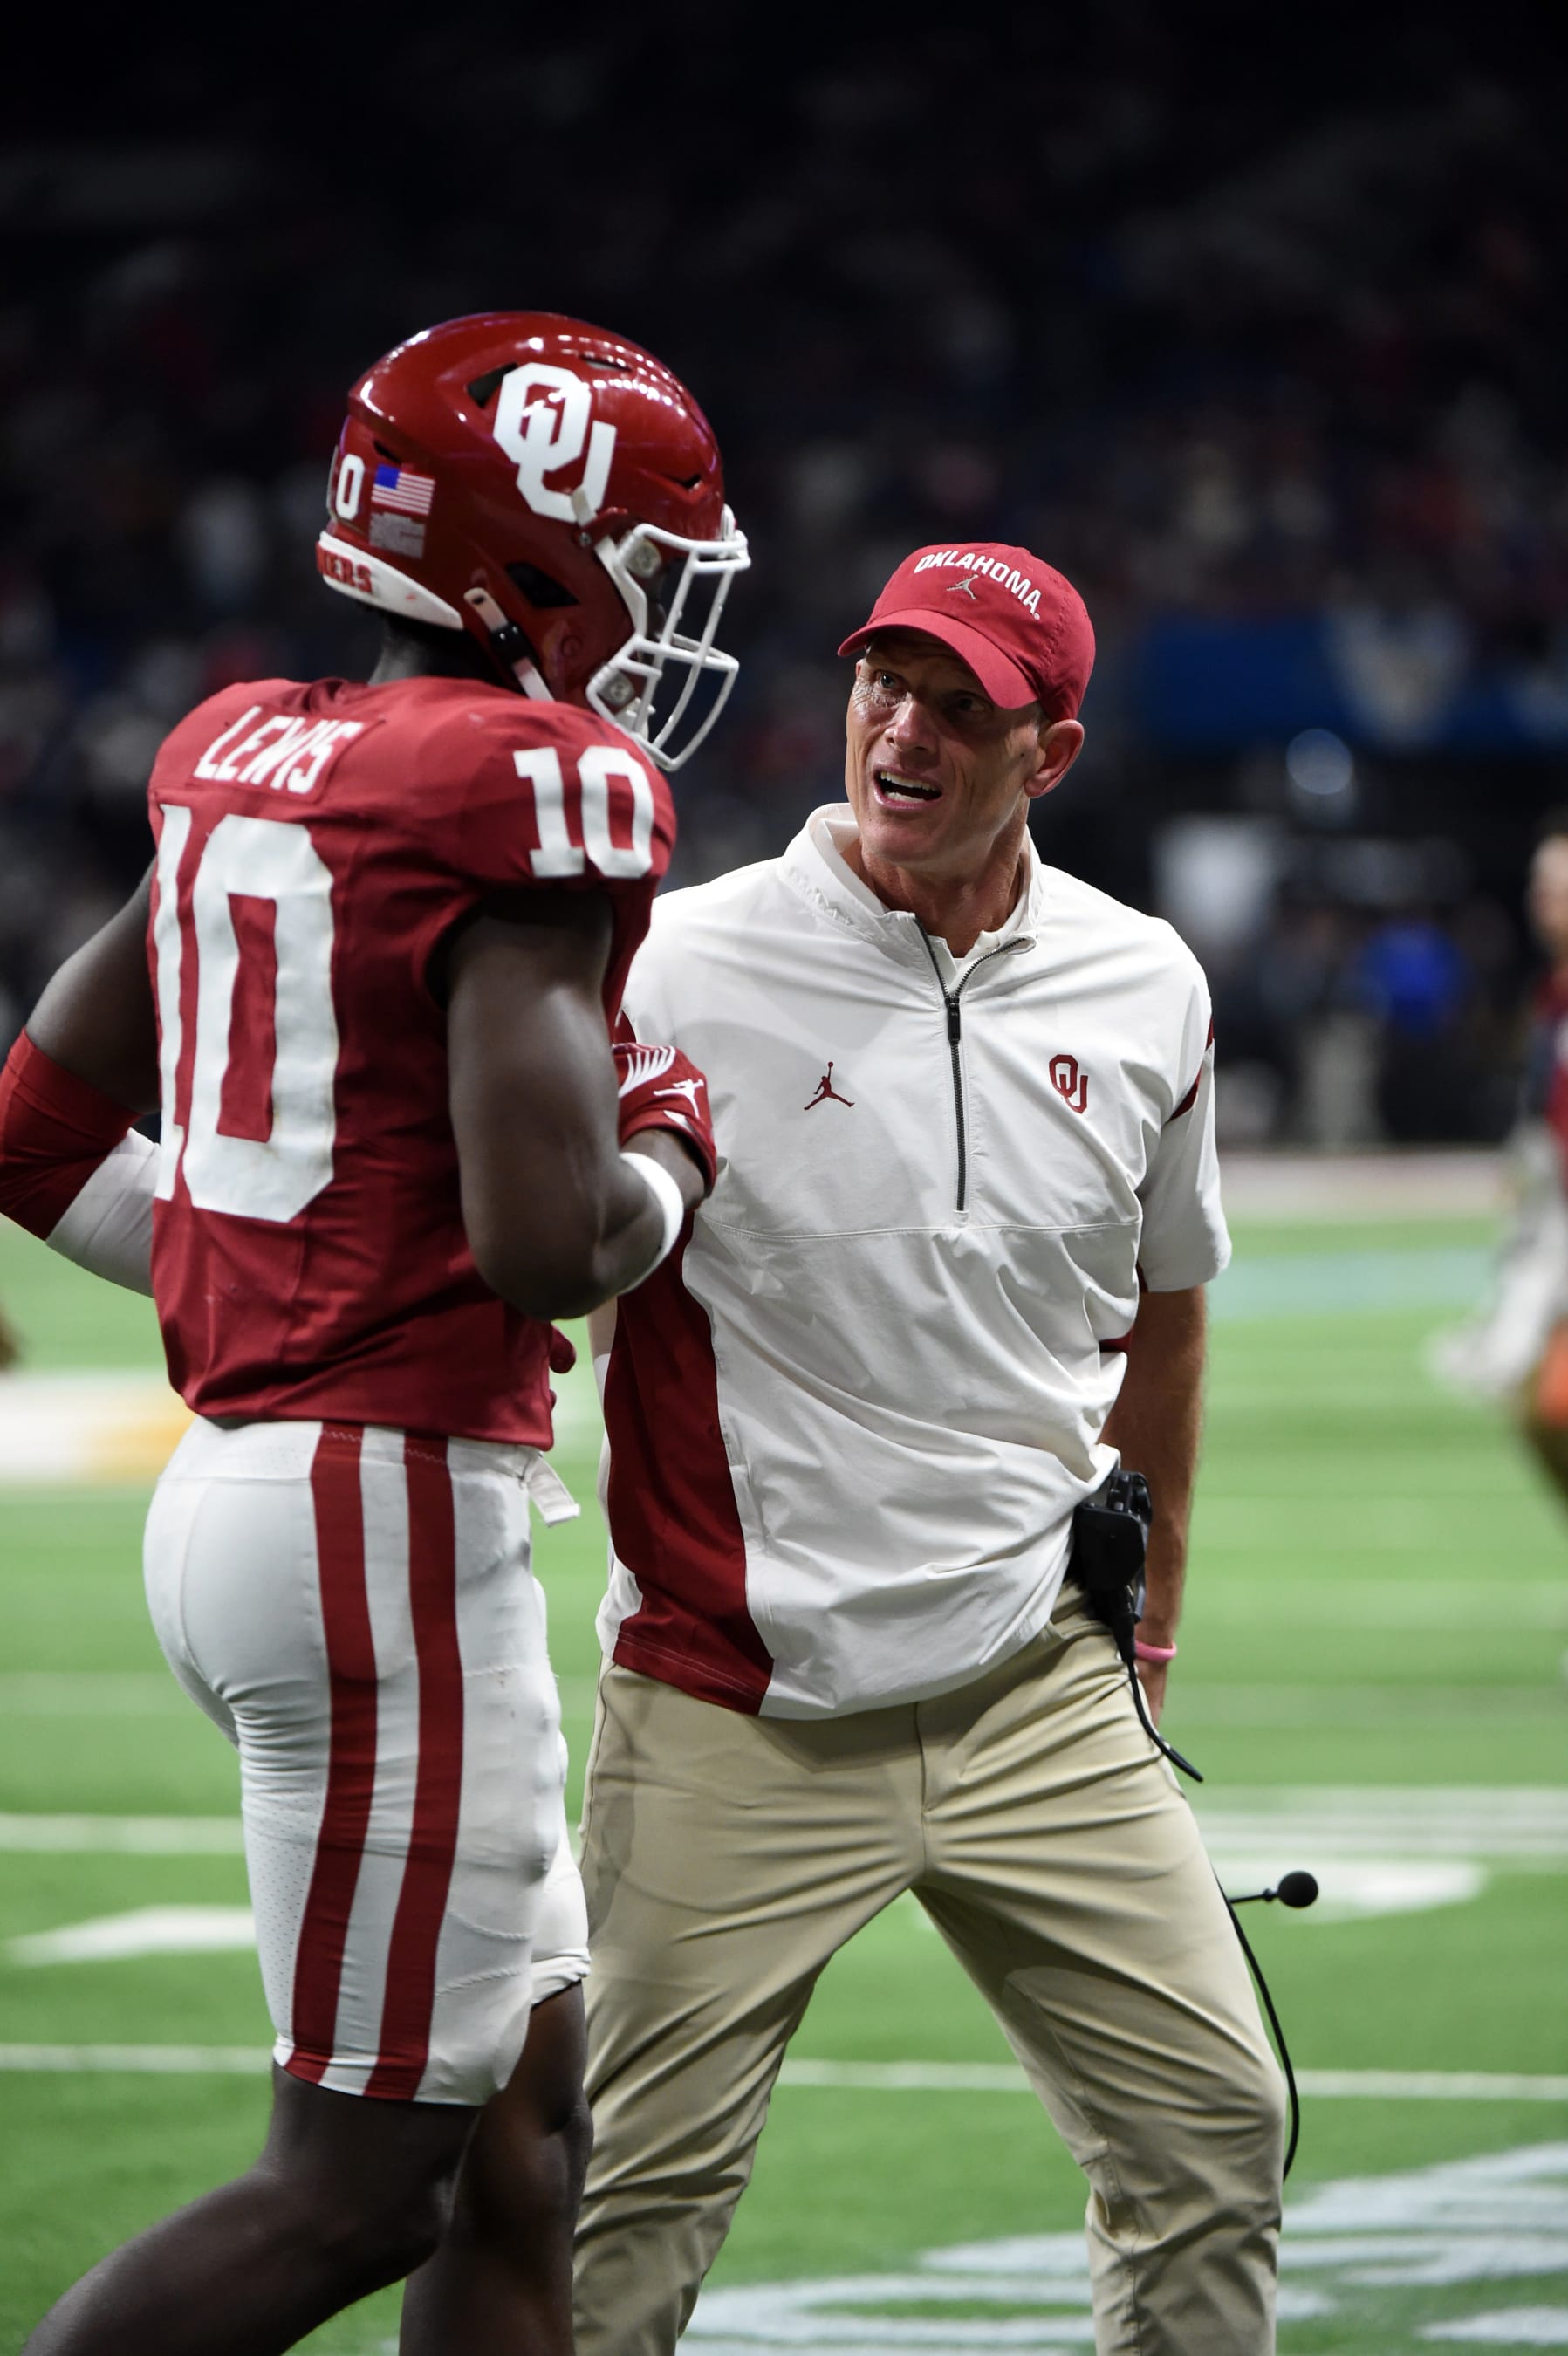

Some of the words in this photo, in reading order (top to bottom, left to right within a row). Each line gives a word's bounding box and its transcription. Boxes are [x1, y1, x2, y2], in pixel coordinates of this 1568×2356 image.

[493, 362, 617, 524] OU
[914, 550, 1042, 618] OKLAHOMA
[193, 705, 365, 794] LEWIS
[512, 745, 654, 878] 10
[153, 803, 339, 1223] 10
[1049, 1053, 1088, 1114] OU
